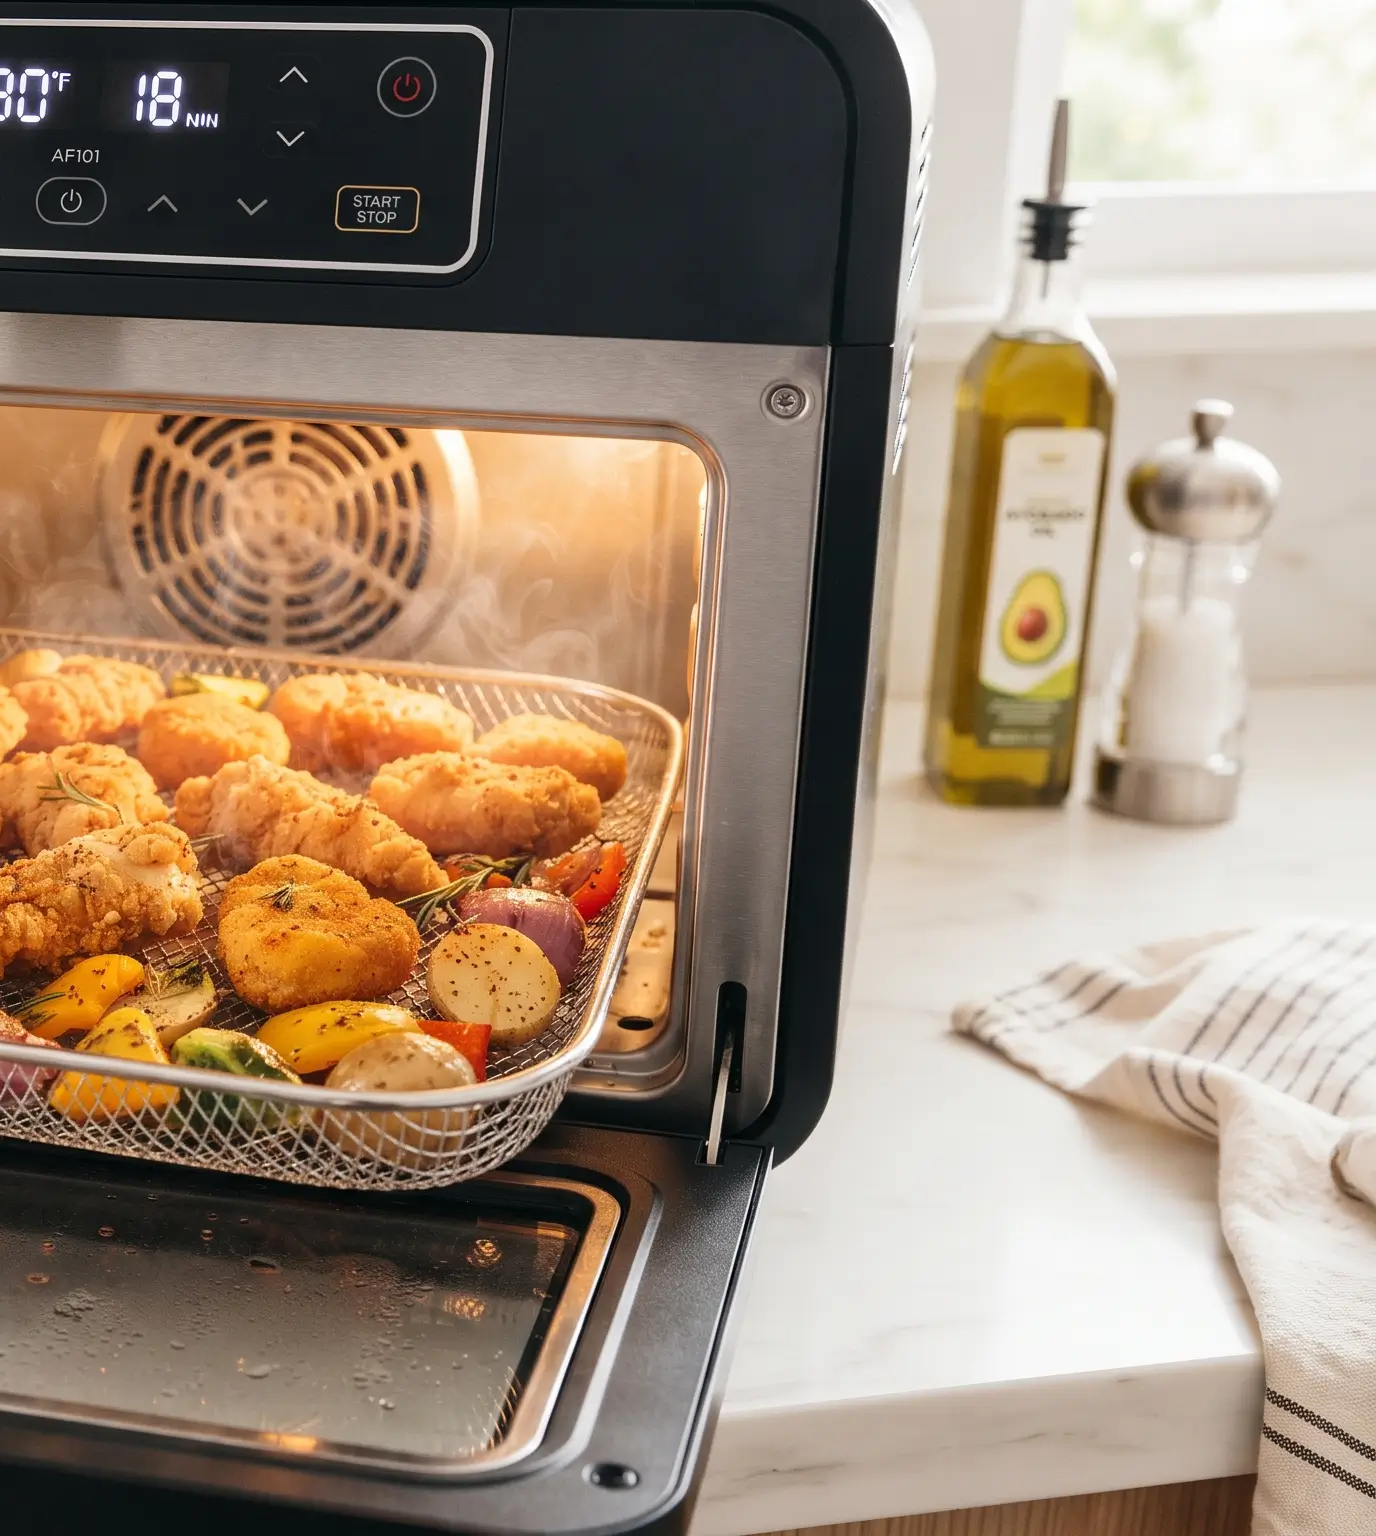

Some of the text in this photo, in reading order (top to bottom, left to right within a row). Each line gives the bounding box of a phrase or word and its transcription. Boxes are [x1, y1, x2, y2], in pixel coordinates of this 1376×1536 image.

[135, 70, 183, 127] 18
[51, 148, 100, 164] AF101
[353, 194, 401, 208] START
[356, 210, 397, 224] STOP
